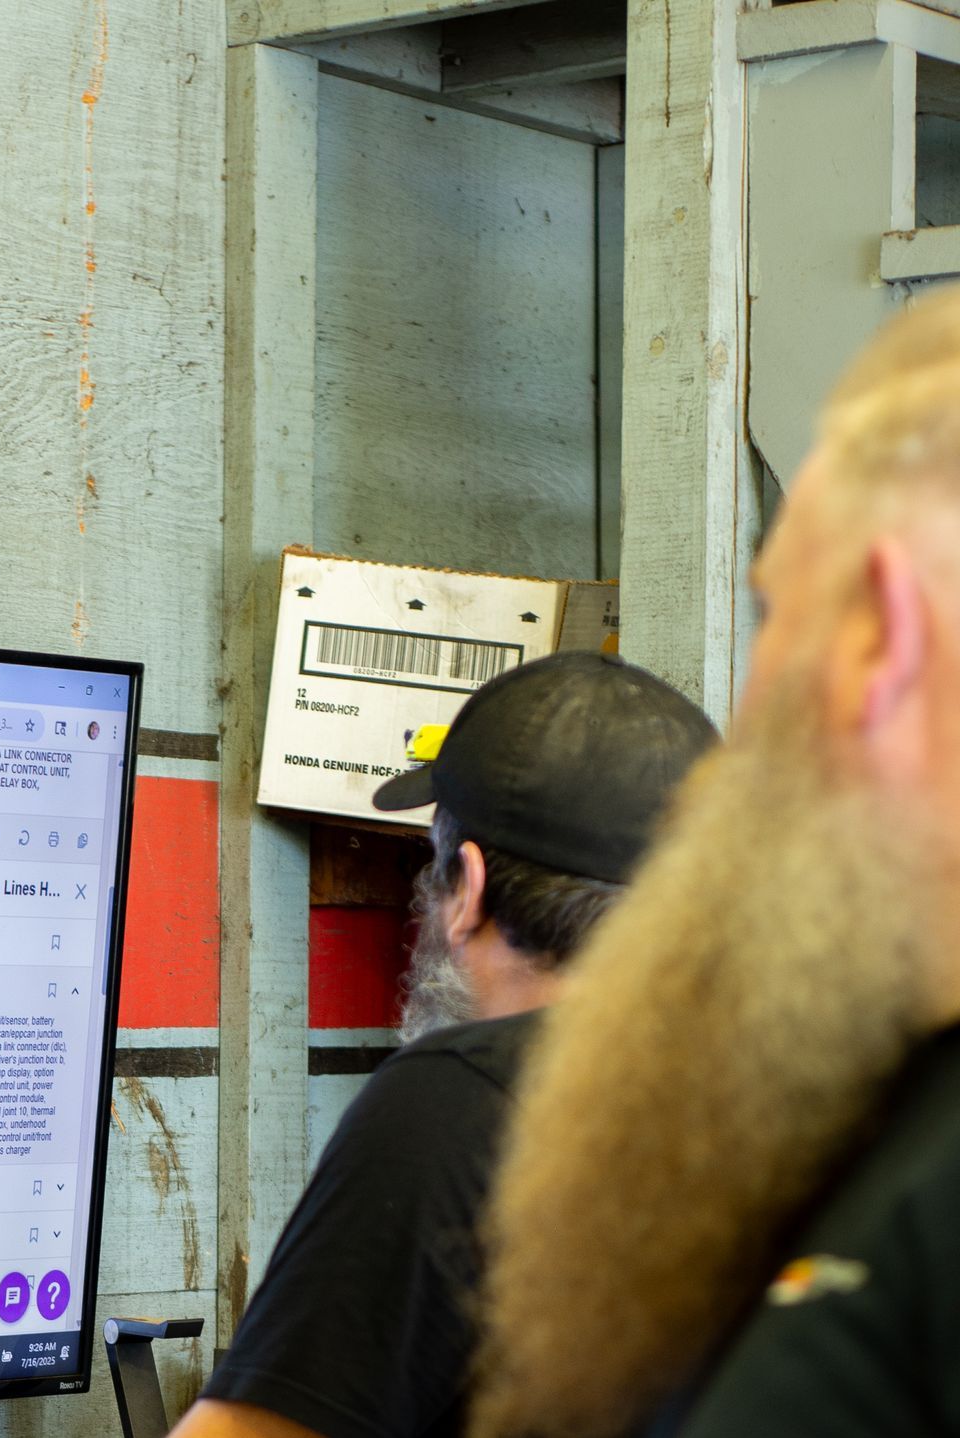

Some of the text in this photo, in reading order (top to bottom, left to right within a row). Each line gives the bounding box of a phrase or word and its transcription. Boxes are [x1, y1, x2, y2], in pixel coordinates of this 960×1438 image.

[297, 688, 306, 698] 12
[295, 700, 360, 716] P/N 08200-HCF2
[3, 748, 22, 760] LINK
[24, 750, 72, 764] CONNECTOR
[11, 764, 47, 776] CONTROL
[50, 766, 70, 778] UNIT,
[284, 754, 401, 778] HONDA GENUINE HCF-2
[20, 779, 39, 791] BOX,
[3, 879, 36, 896] Lines
[31, 1015, 54, 1027] battery
[36, 1028, 63, 1039] junction
[28, 1342, 56, 1352] 9:26 AM
[21, 1356, 56, 1368] 7/16/2025
